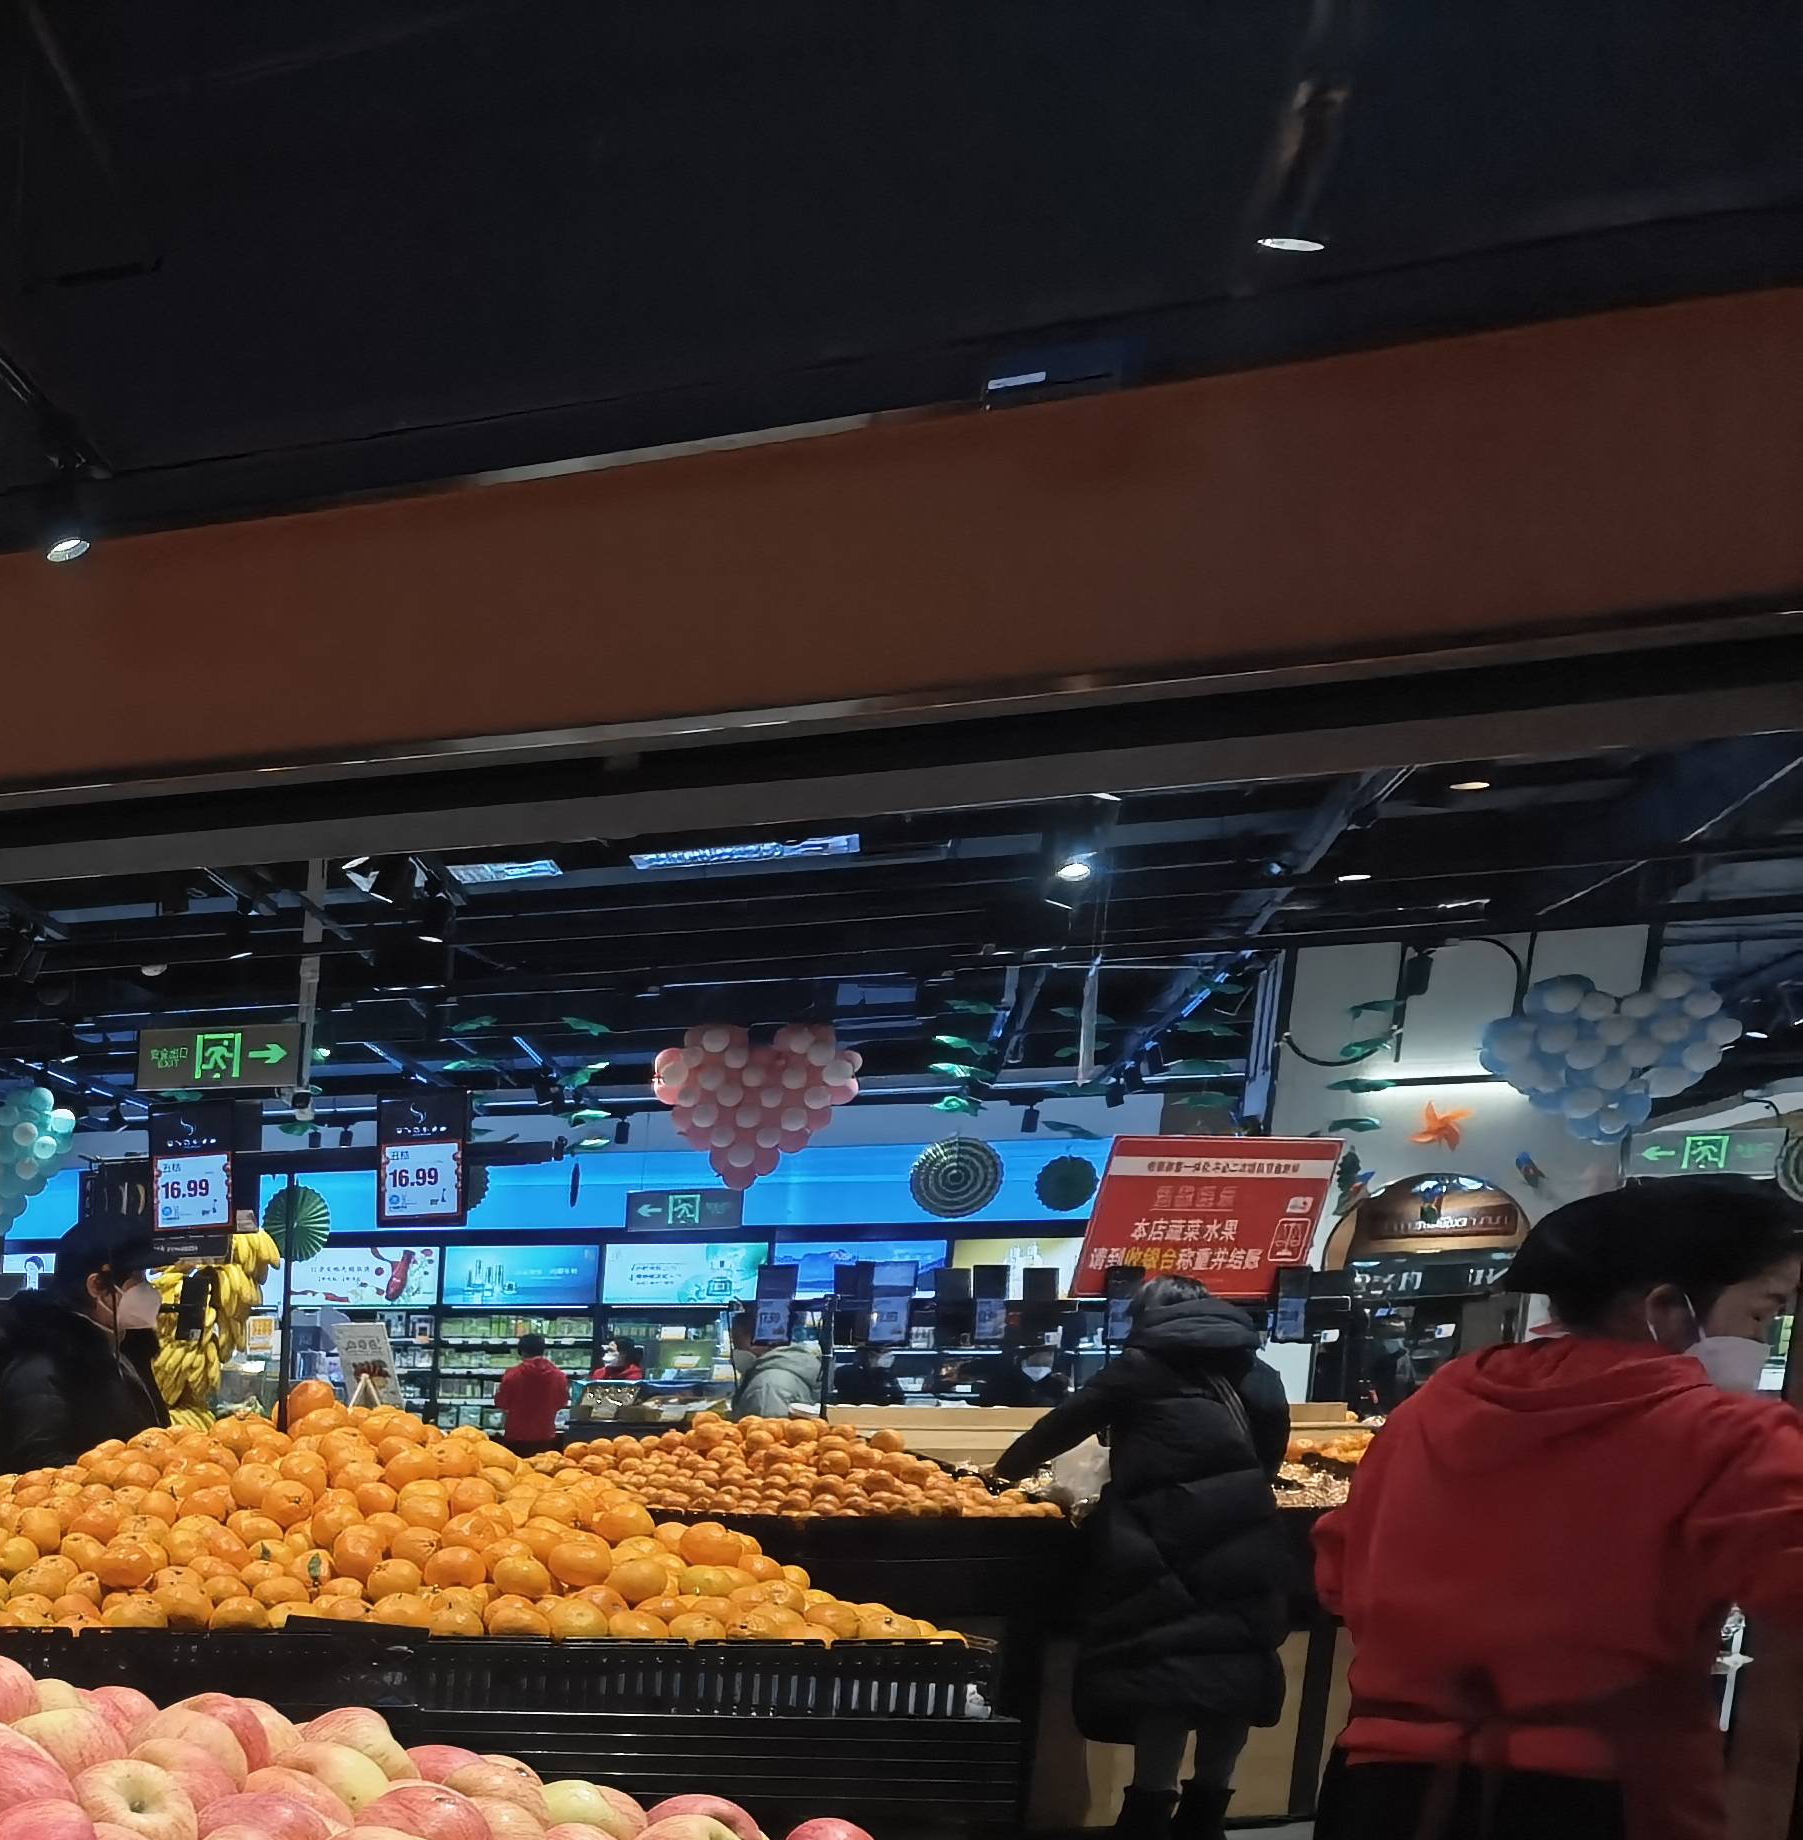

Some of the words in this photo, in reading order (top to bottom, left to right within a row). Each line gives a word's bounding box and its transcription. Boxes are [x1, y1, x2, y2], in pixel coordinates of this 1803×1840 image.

[161, 1178, 210, 1199] 16.99
[389, 1167, 439, 1188] 16.99
[1130, 1218, 1239, 1242] 本店蔬菜水果
[1089, 1247, 1263, 1272] 请到收银台称重并结账
